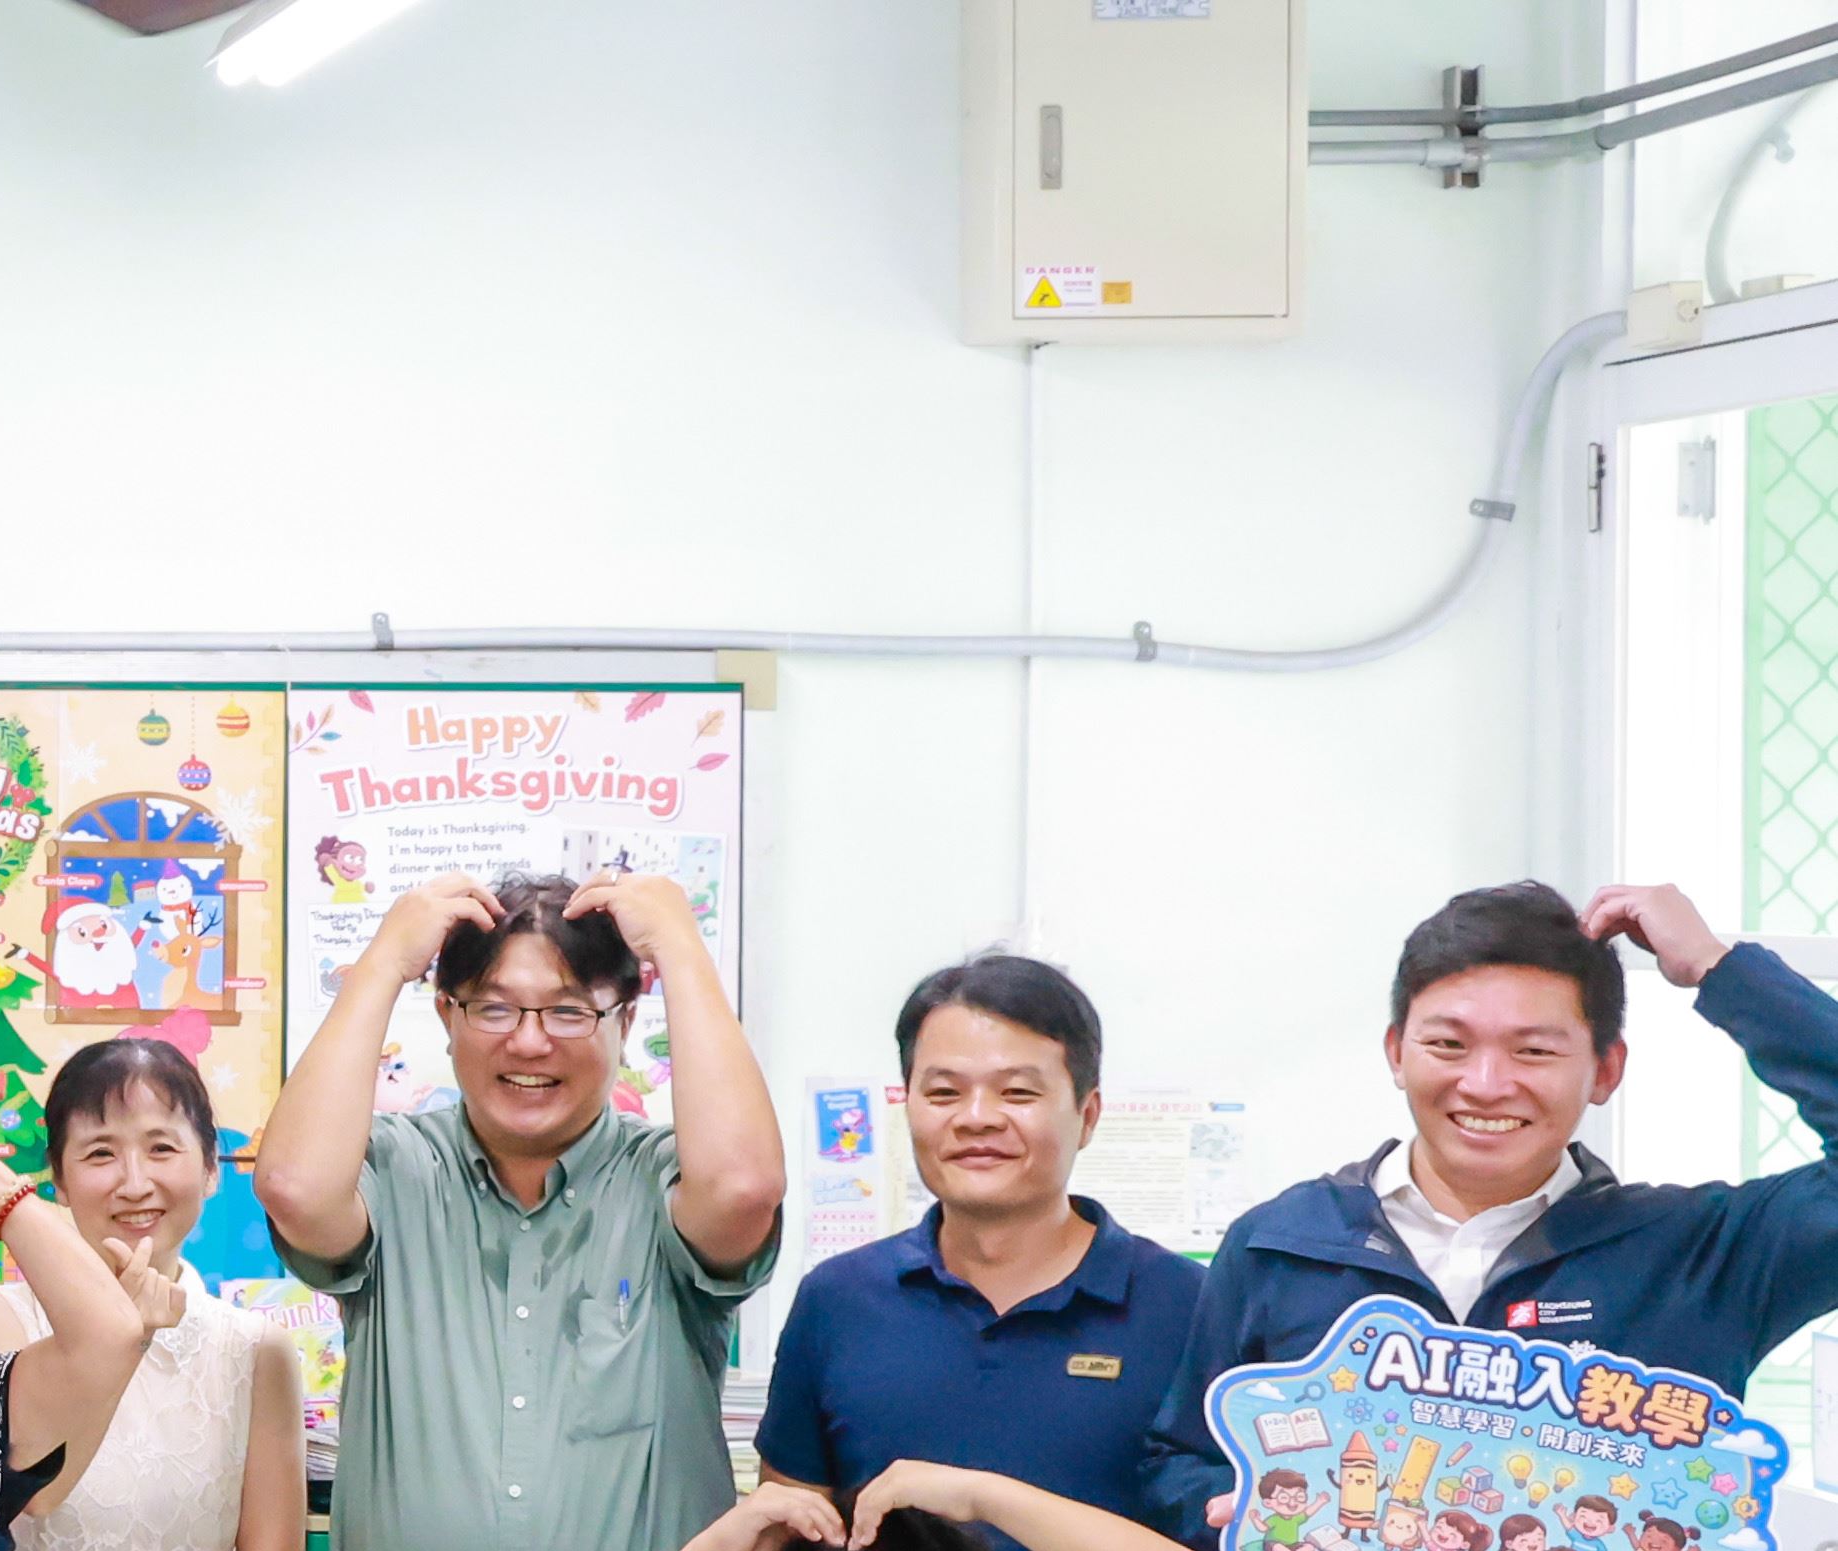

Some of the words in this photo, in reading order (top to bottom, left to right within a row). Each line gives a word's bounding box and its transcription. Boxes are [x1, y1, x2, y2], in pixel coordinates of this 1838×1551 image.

[406, 706, 563, 754] Happy
[321, 756, 679, 818] Thanksgiving
[388, 826, 424, 838] Today
[428, 826, 438, 836] is
[442, 822, 530, 836] Thanksgiving.
[389, 845, 410, 855] I'm
[414, 843, 452, 858] happy
[456, 844, 468, 853] to
[472, 841, 502, 852] have
[389, 863, 430, 874] dinner
[434, 861, 460, 872] with
[465, 862, 482, 873] my
[486, 859, 531, 870] friends
[389, 882, 413, 893] and
[1368, 1331, 1712, 1452] AI融入教學
[1410, 1400, 1517, 1441] 智慧學習
[1538, 1424, 1647, 1470] 開創未來
